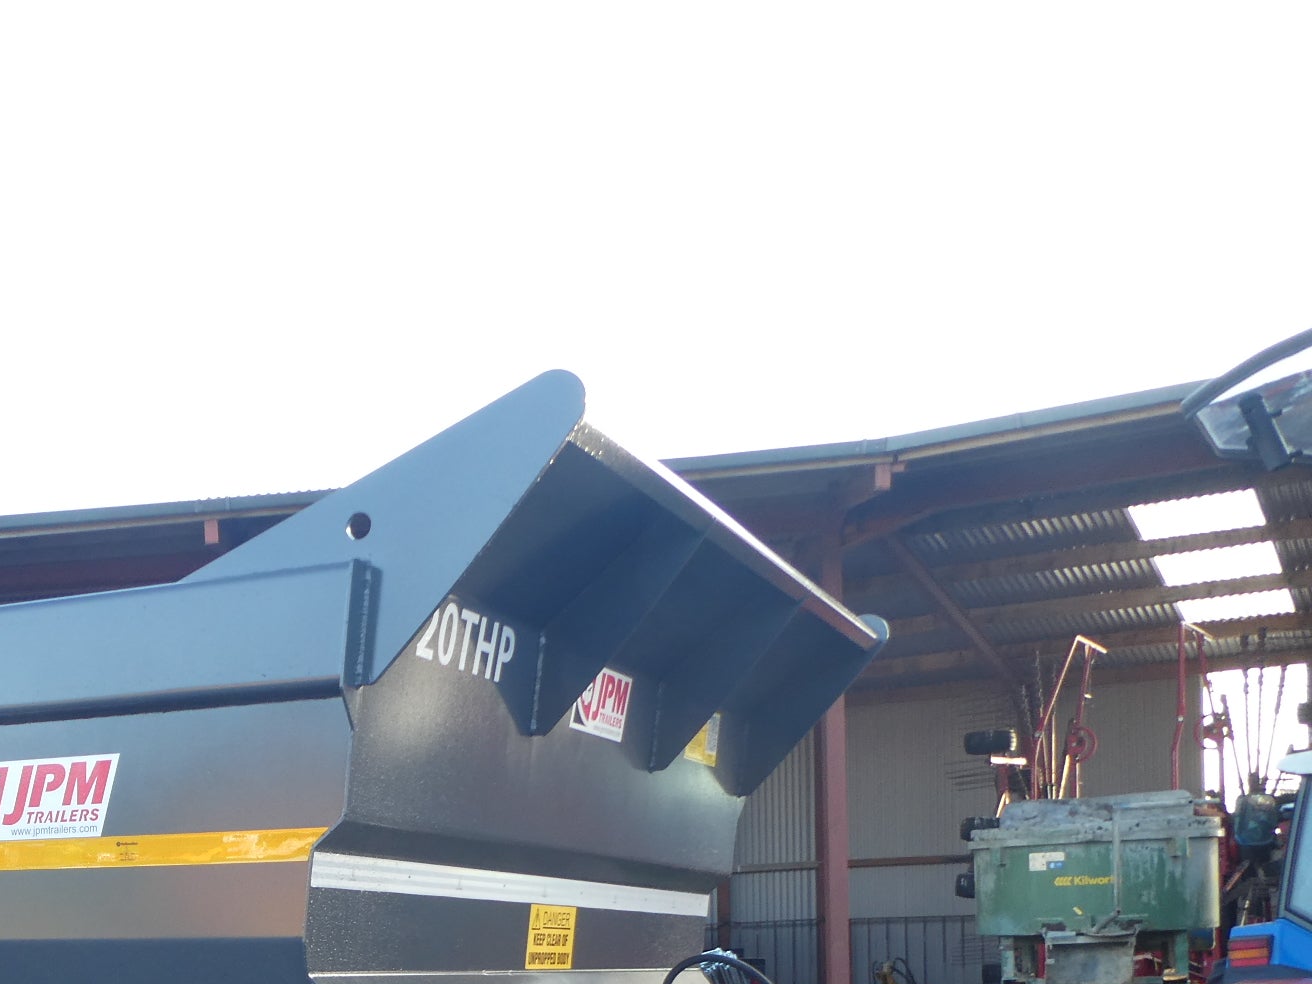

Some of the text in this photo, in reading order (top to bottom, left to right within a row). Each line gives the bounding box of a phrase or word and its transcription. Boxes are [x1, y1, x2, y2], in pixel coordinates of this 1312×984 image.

[415, 602, 516, 683] 20THP
[591, 673, 630, 721] JPM
[2, 760, 112, 825] JPM
[26, 808, 100, 824] TRAILERS
[11, 824, 98, 837] www.jpmtrailers.com
